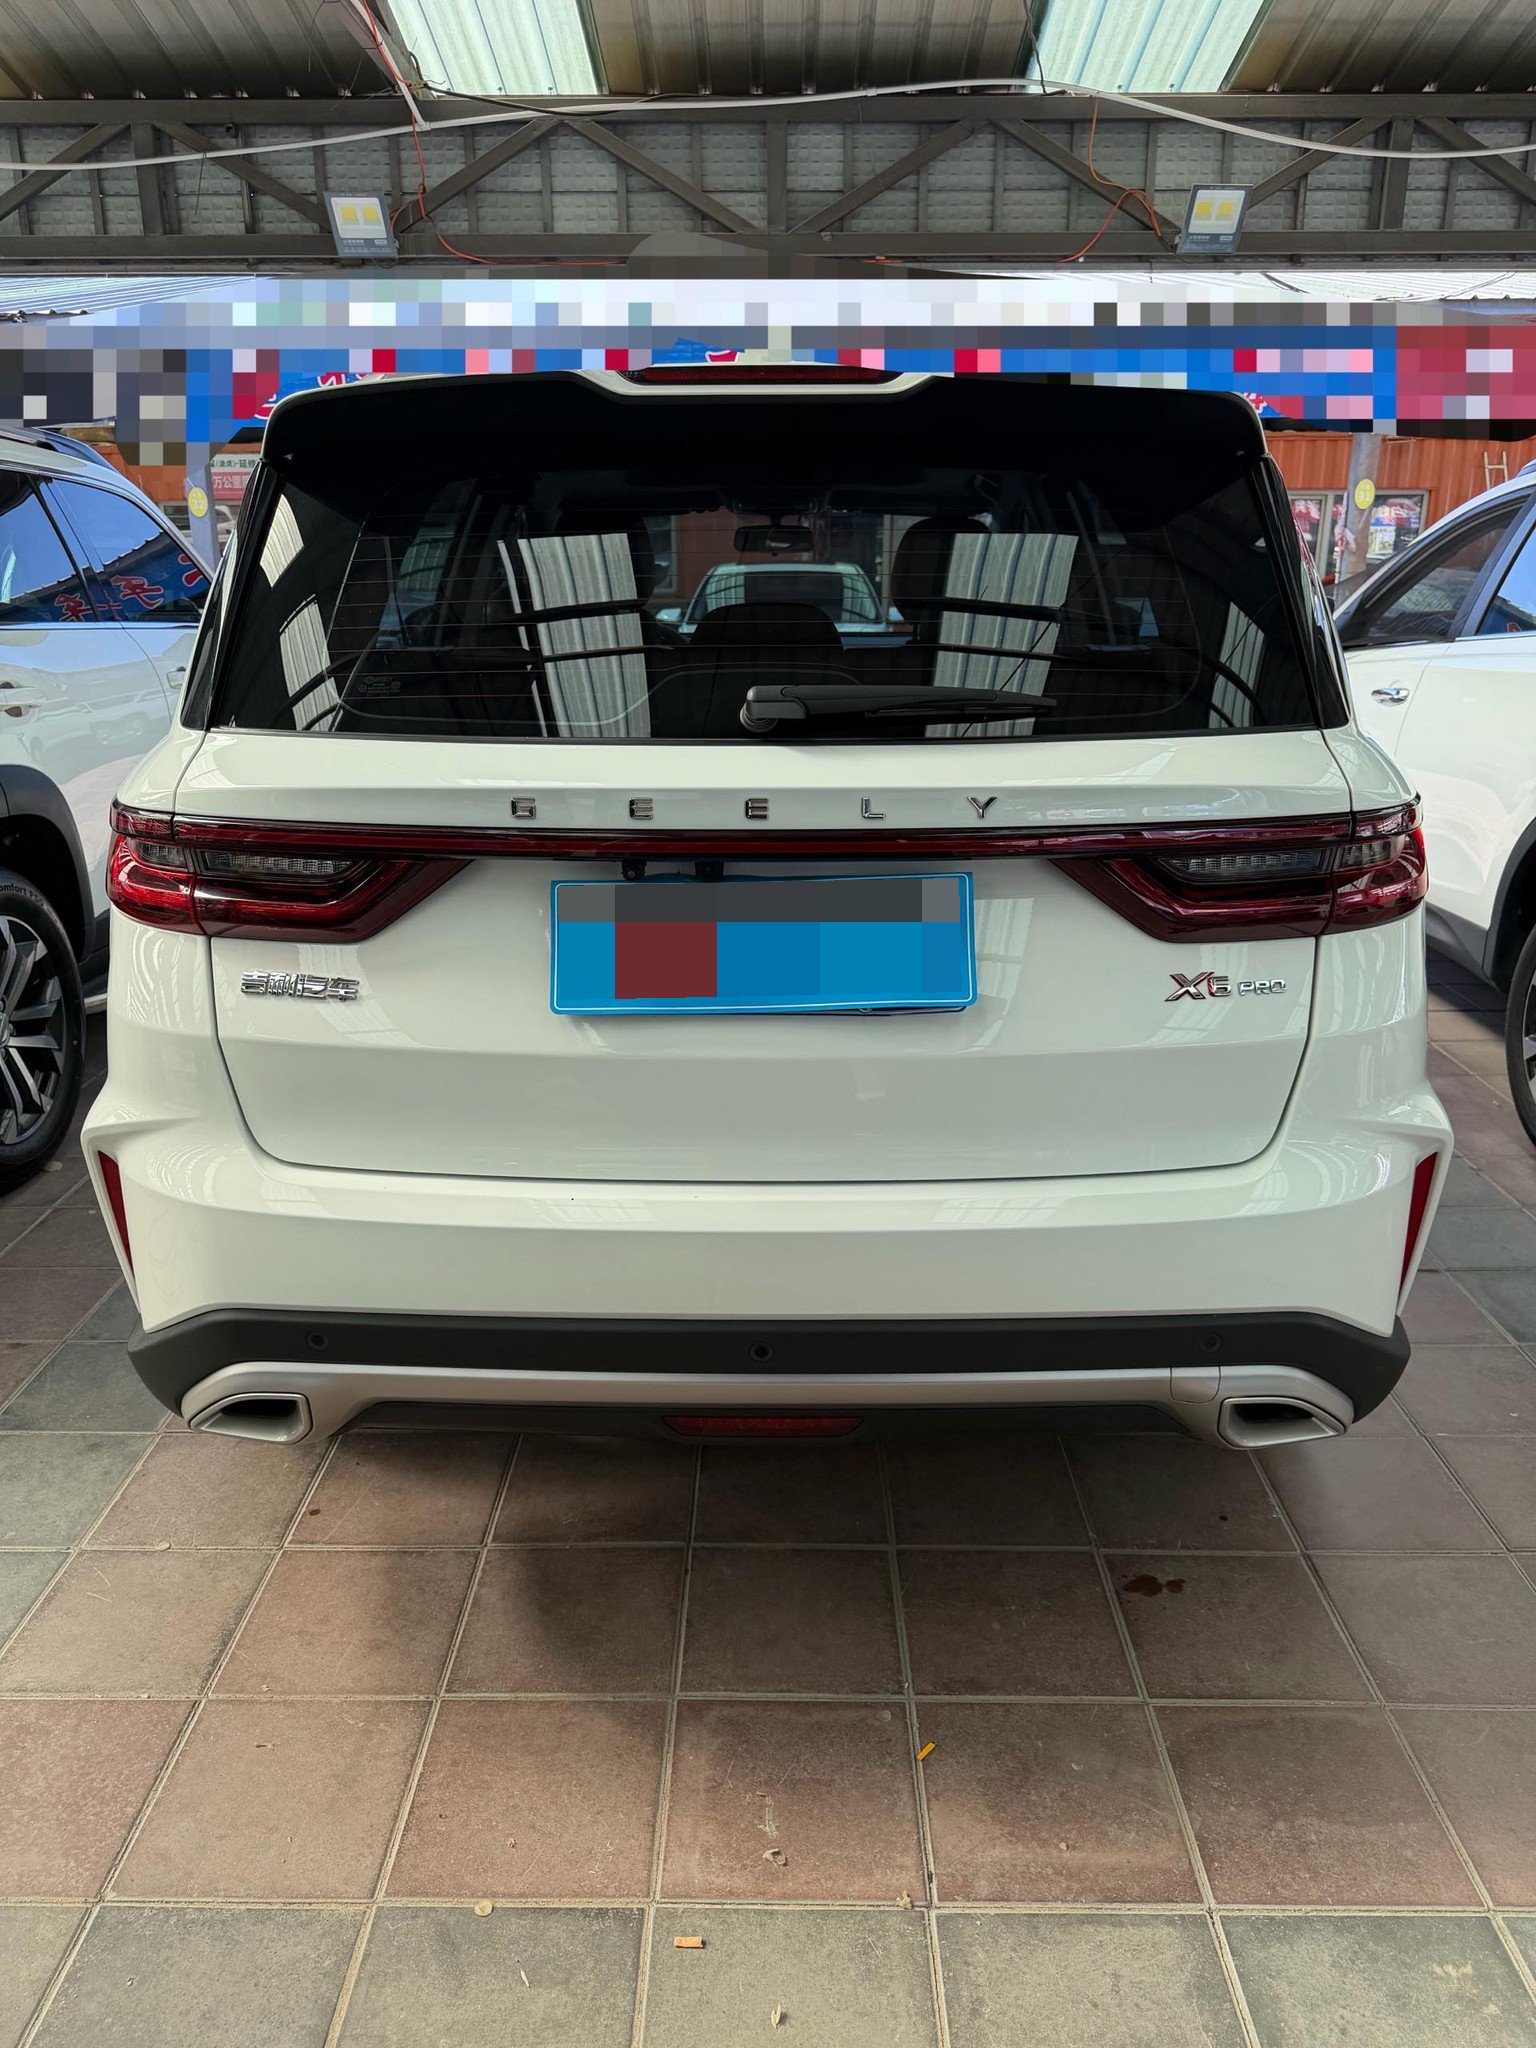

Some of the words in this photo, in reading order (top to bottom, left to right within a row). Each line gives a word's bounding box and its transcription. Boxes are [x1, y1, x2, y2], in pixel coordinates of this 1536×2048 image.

[510, 796, 998, 820] GEELY
[241, 970, 359, 1001] 吉利汽车
[1165, 971, 1231, 1001] X6
[1238, 979, 1287, 996] PRO
